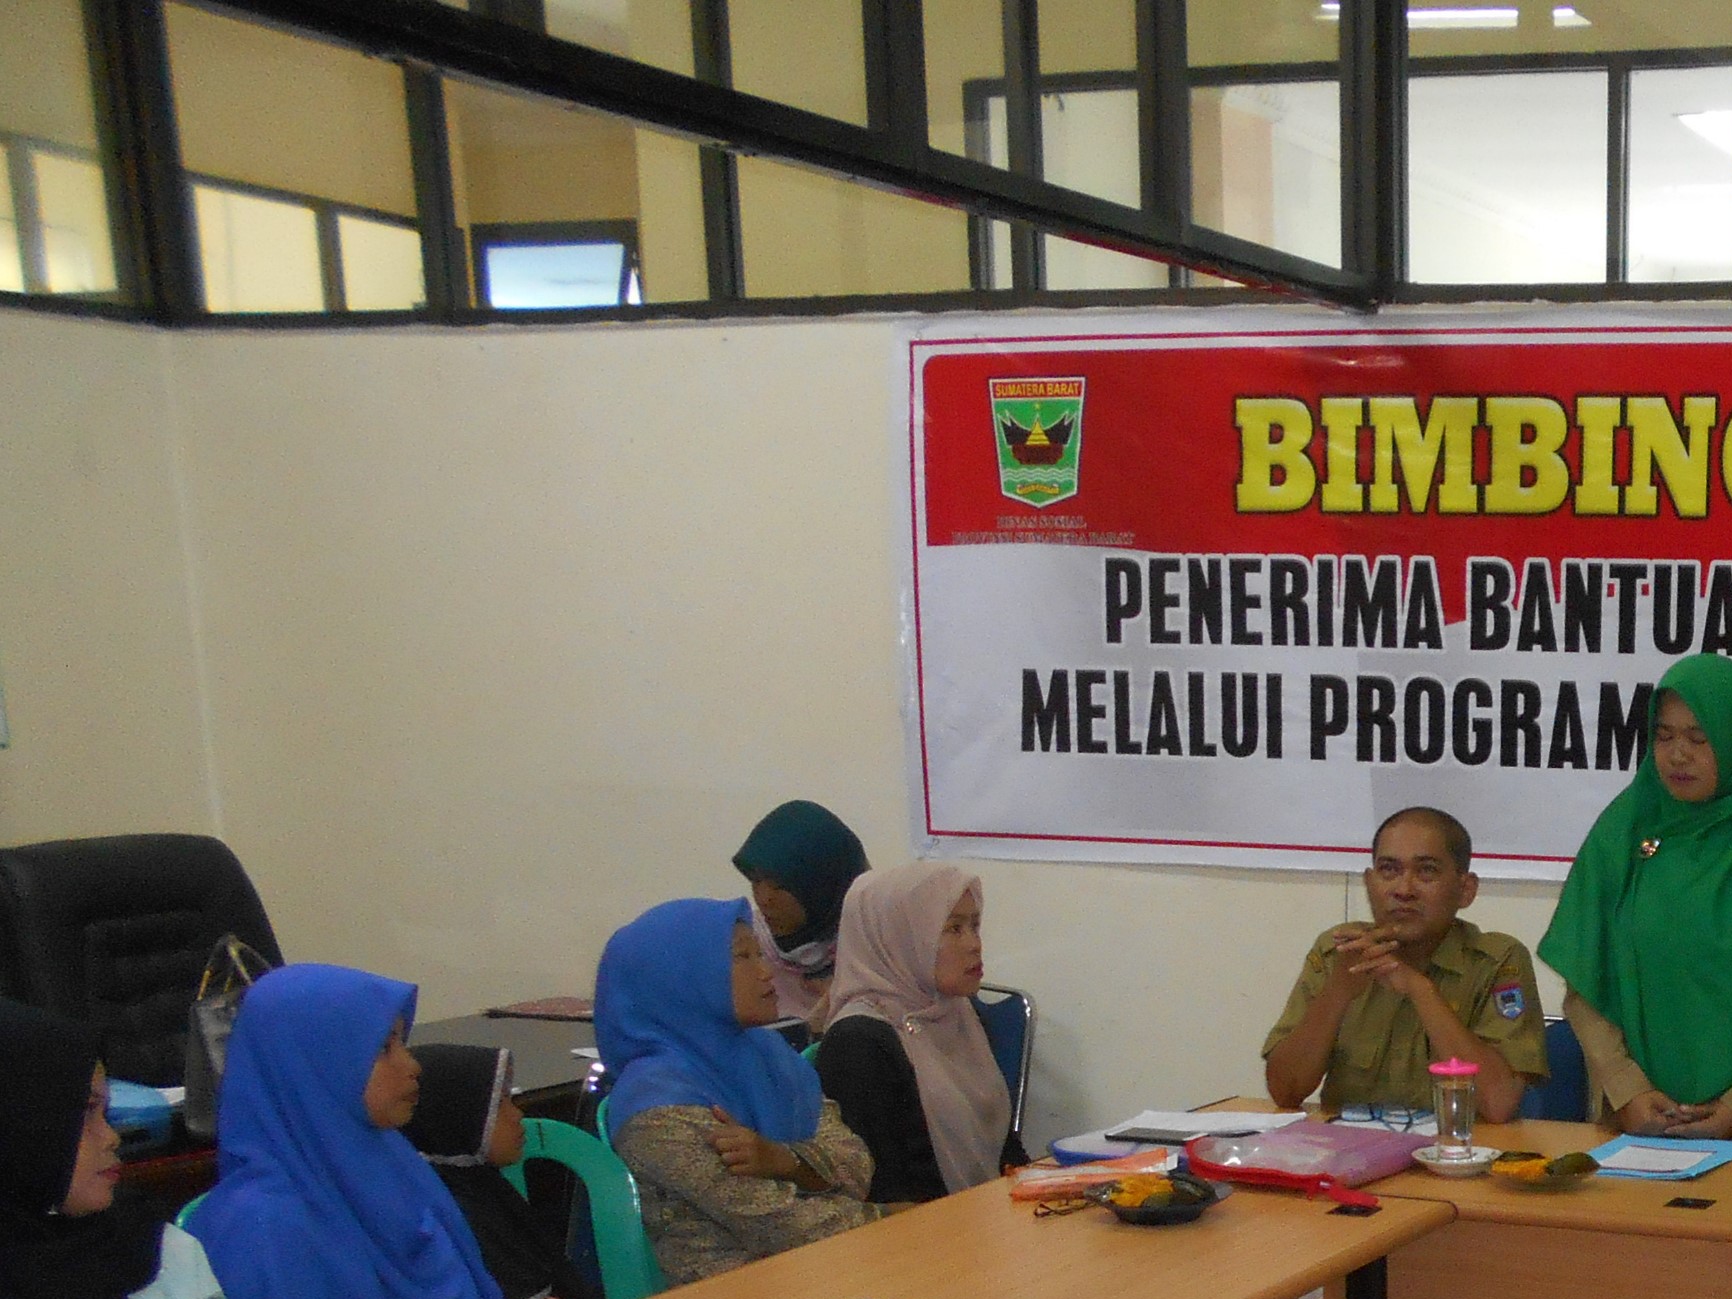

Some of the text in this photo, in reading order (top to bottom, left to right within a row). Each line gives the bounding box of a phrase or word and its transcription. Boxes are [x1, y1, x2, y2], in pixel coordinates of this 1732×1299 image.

[995, 381, 1080, 397] SUMATERA BARAT
[1105, 557, 1444, 651] PENERIMA
[1020, 669, 1282, 760] MELALUI
[1310, 673, 1653, 773] PROGRAM
